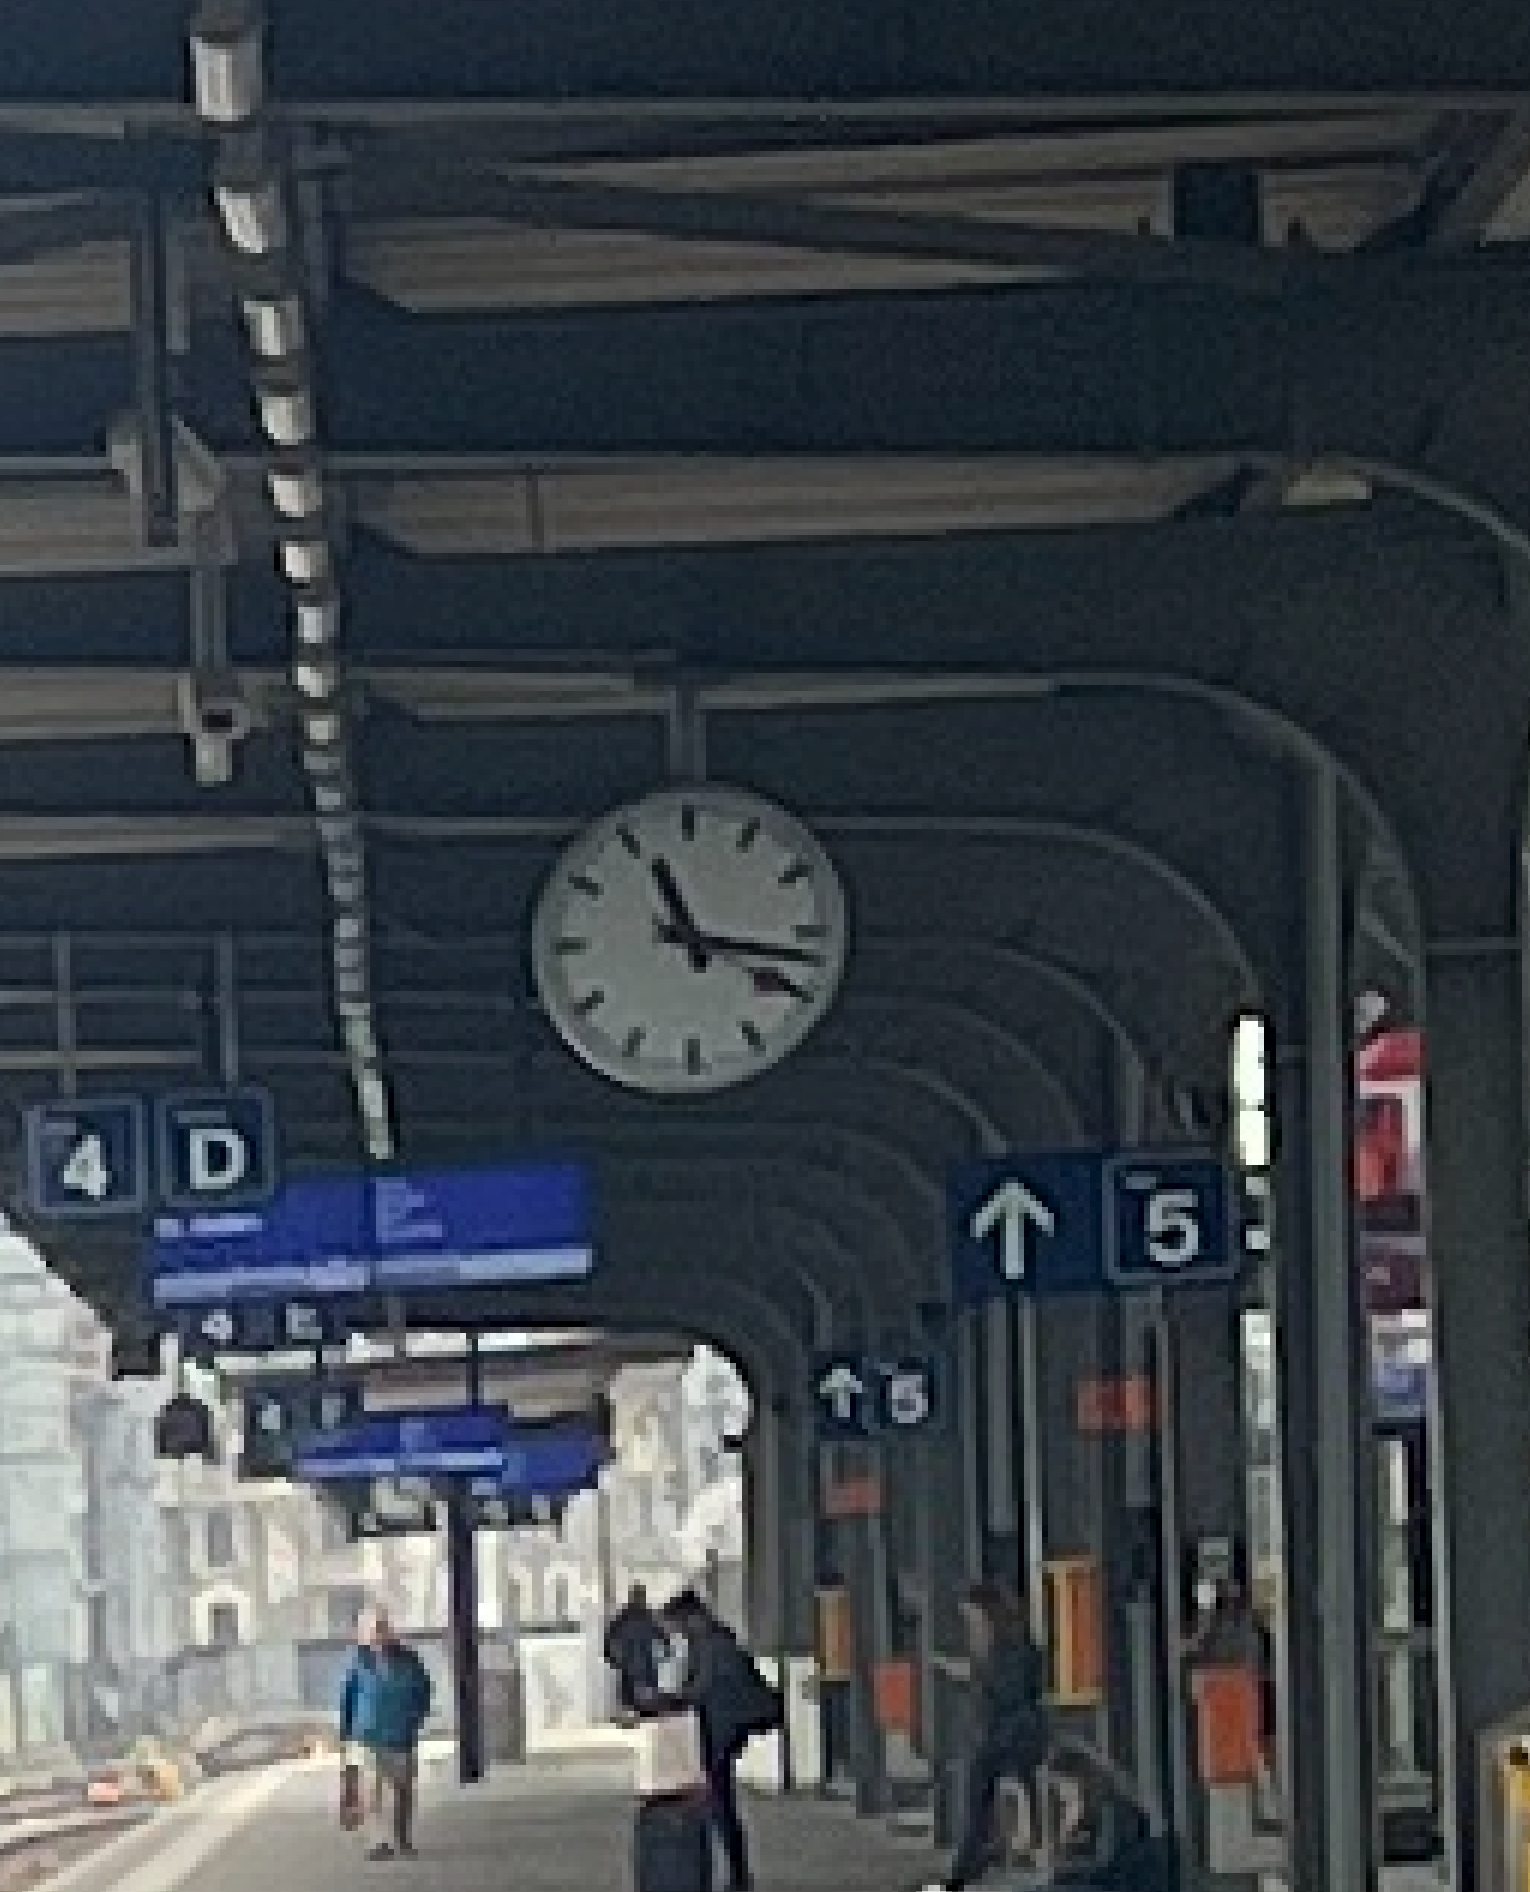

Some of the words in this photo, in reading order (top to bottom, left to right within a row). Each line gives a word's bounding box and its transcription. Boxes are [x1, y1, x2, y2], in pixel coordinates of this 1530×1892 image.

[62, 1134, 107, 1198] 4
[190, 1129, 244, 1190] D
[1149, 1189, 1199, 1263] 5
